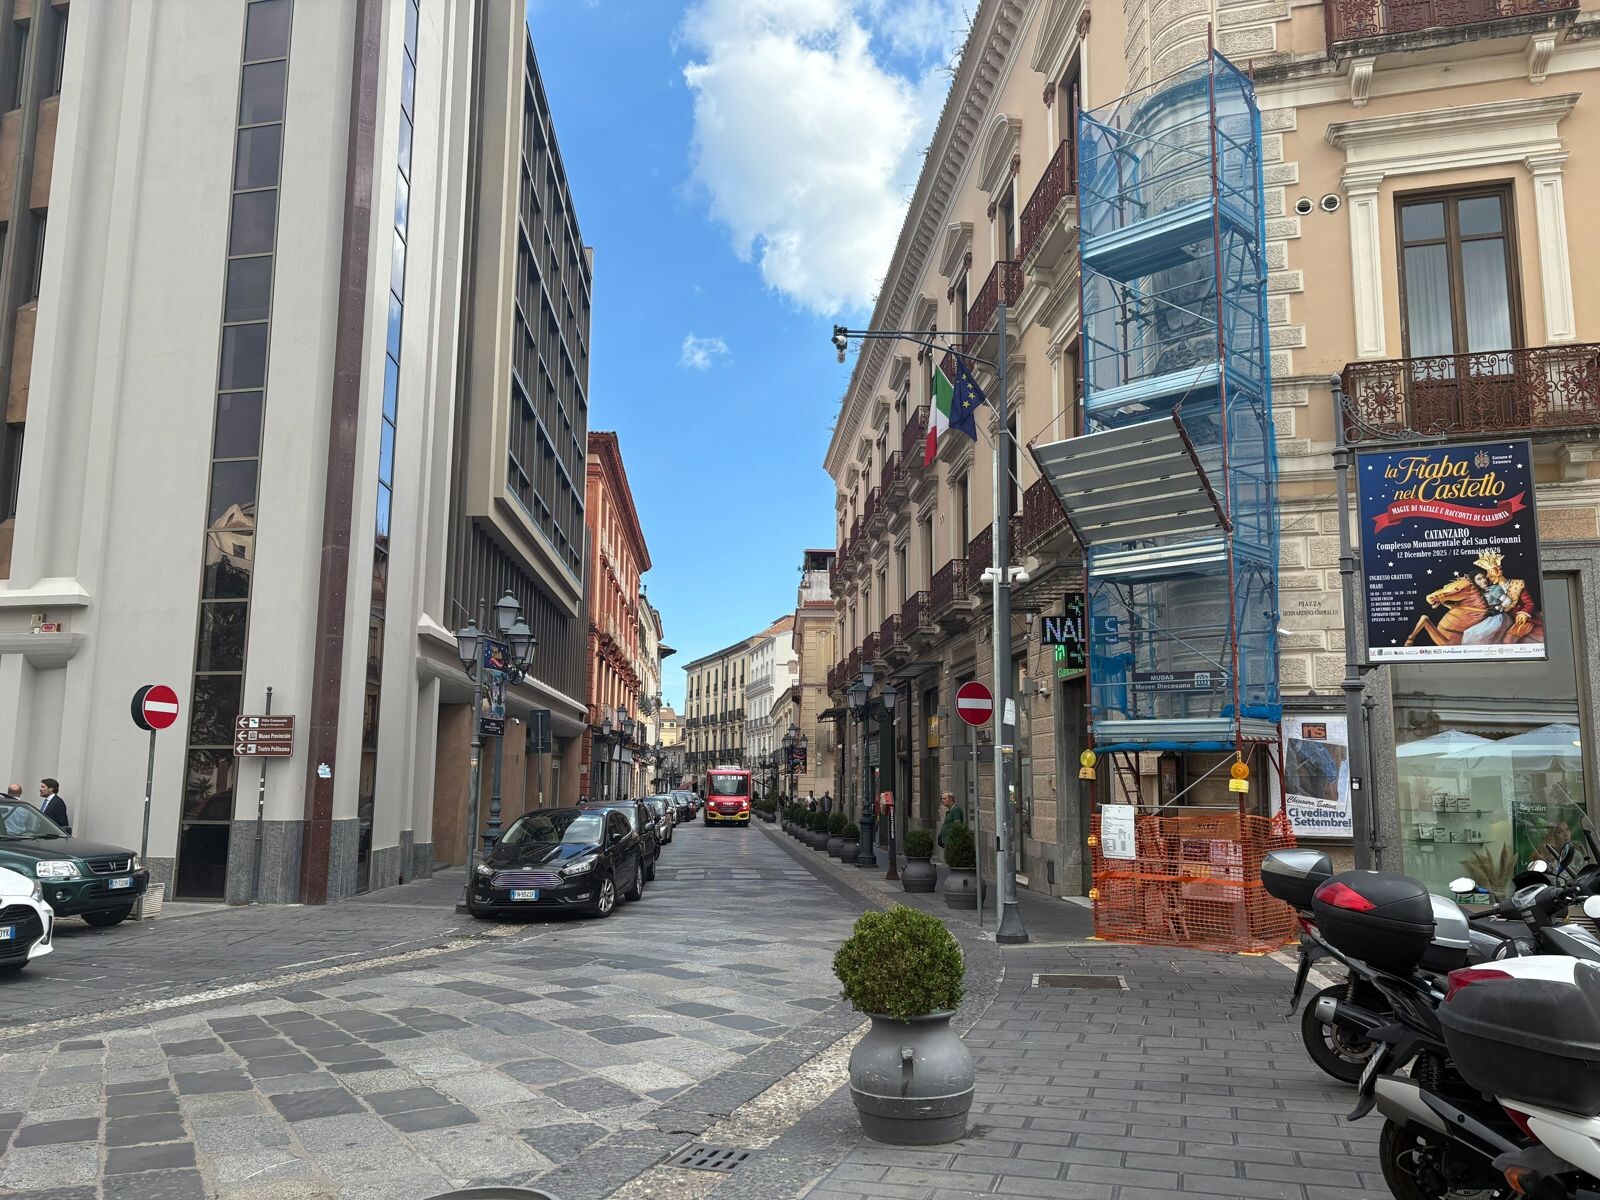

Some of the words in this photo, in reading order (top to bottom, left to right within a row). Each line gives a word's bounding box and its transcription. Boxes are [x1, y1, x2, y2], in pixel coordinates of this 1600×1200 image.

[1385, 464, 1399, 478] la
[1395, 454, 1469, 484] Fiaba
[1394, 485, 1416, 500] nel
[1418, 471, 1505, 502] Castello
[1392, 505, 1410, 515] MAGIE
[1418, 505, 1439, 514] NATALE
[1444, 508, 1472, 521] RACCONTI
[1481, 510, 1510, 522] CALABRIA
[1424, 528, 1470, 540] CATANZARO
[1376, 541, 1412, 552] Complesso
[1412, 538, 1461, 549] Monumentale
[1461, 537, 1474, 546] del
[1474, 536, 1488, 546] San
[1489, 534, 1522, 545] Giovanni
[1404, 549, 1432, 558] Dicembre
[1432, 549, 1448, 557] 2025
[1460, 547, 1485, 556] Gennaio
[1303, 726, 1326, 738] ns
[1288, 808, 1298, 817] Ci
[1301, 808, 1346, 818] vediamo
[1295, 818, 1351, 827] Settembre!
